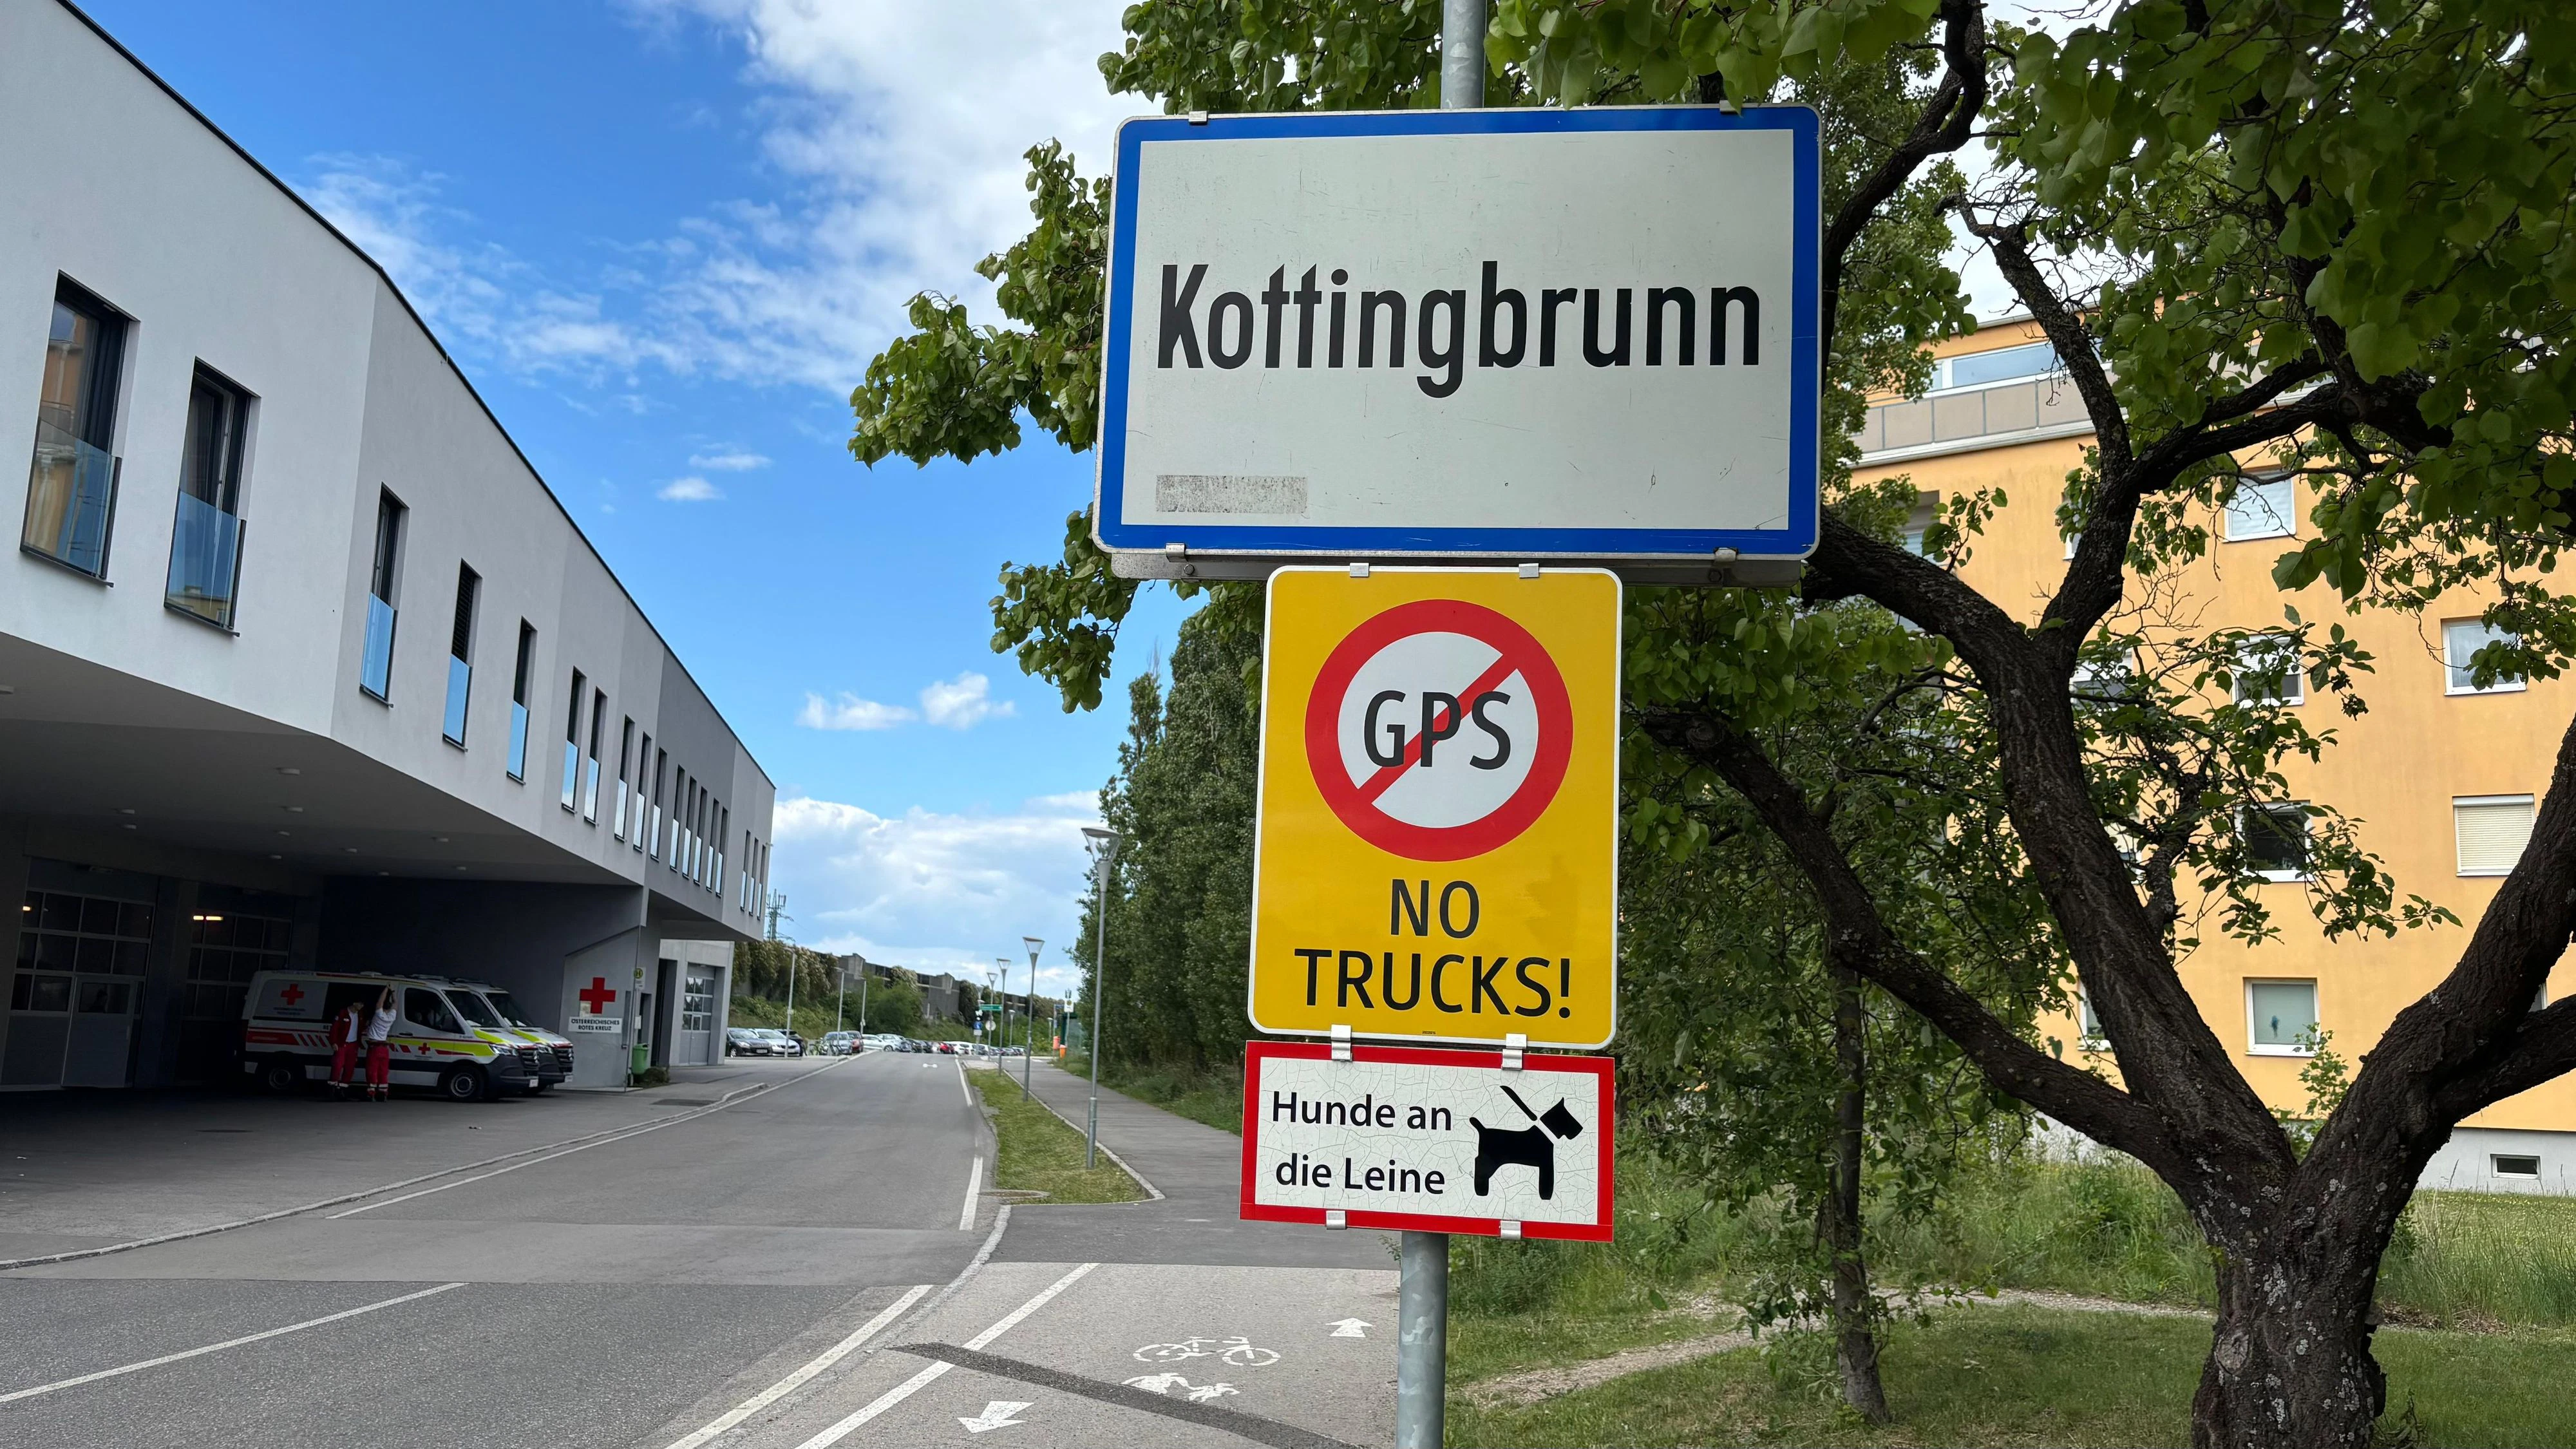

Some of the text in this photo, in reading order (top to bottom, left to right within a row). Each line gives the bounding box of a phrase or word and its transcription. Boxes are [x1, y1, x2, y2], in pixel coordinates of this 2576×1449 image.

[1157, 260, 1761, 399] Kottingbrunn
[1363, 689, 1511, 770] GPS
[1390, 878, 1480, 940] NO
[1294, 948, 1571, 1019] TRUCKS!
[1272, 1091, 1452, 1132] Hunde an
[1275, 1153, 1446, 1195] die Leine
